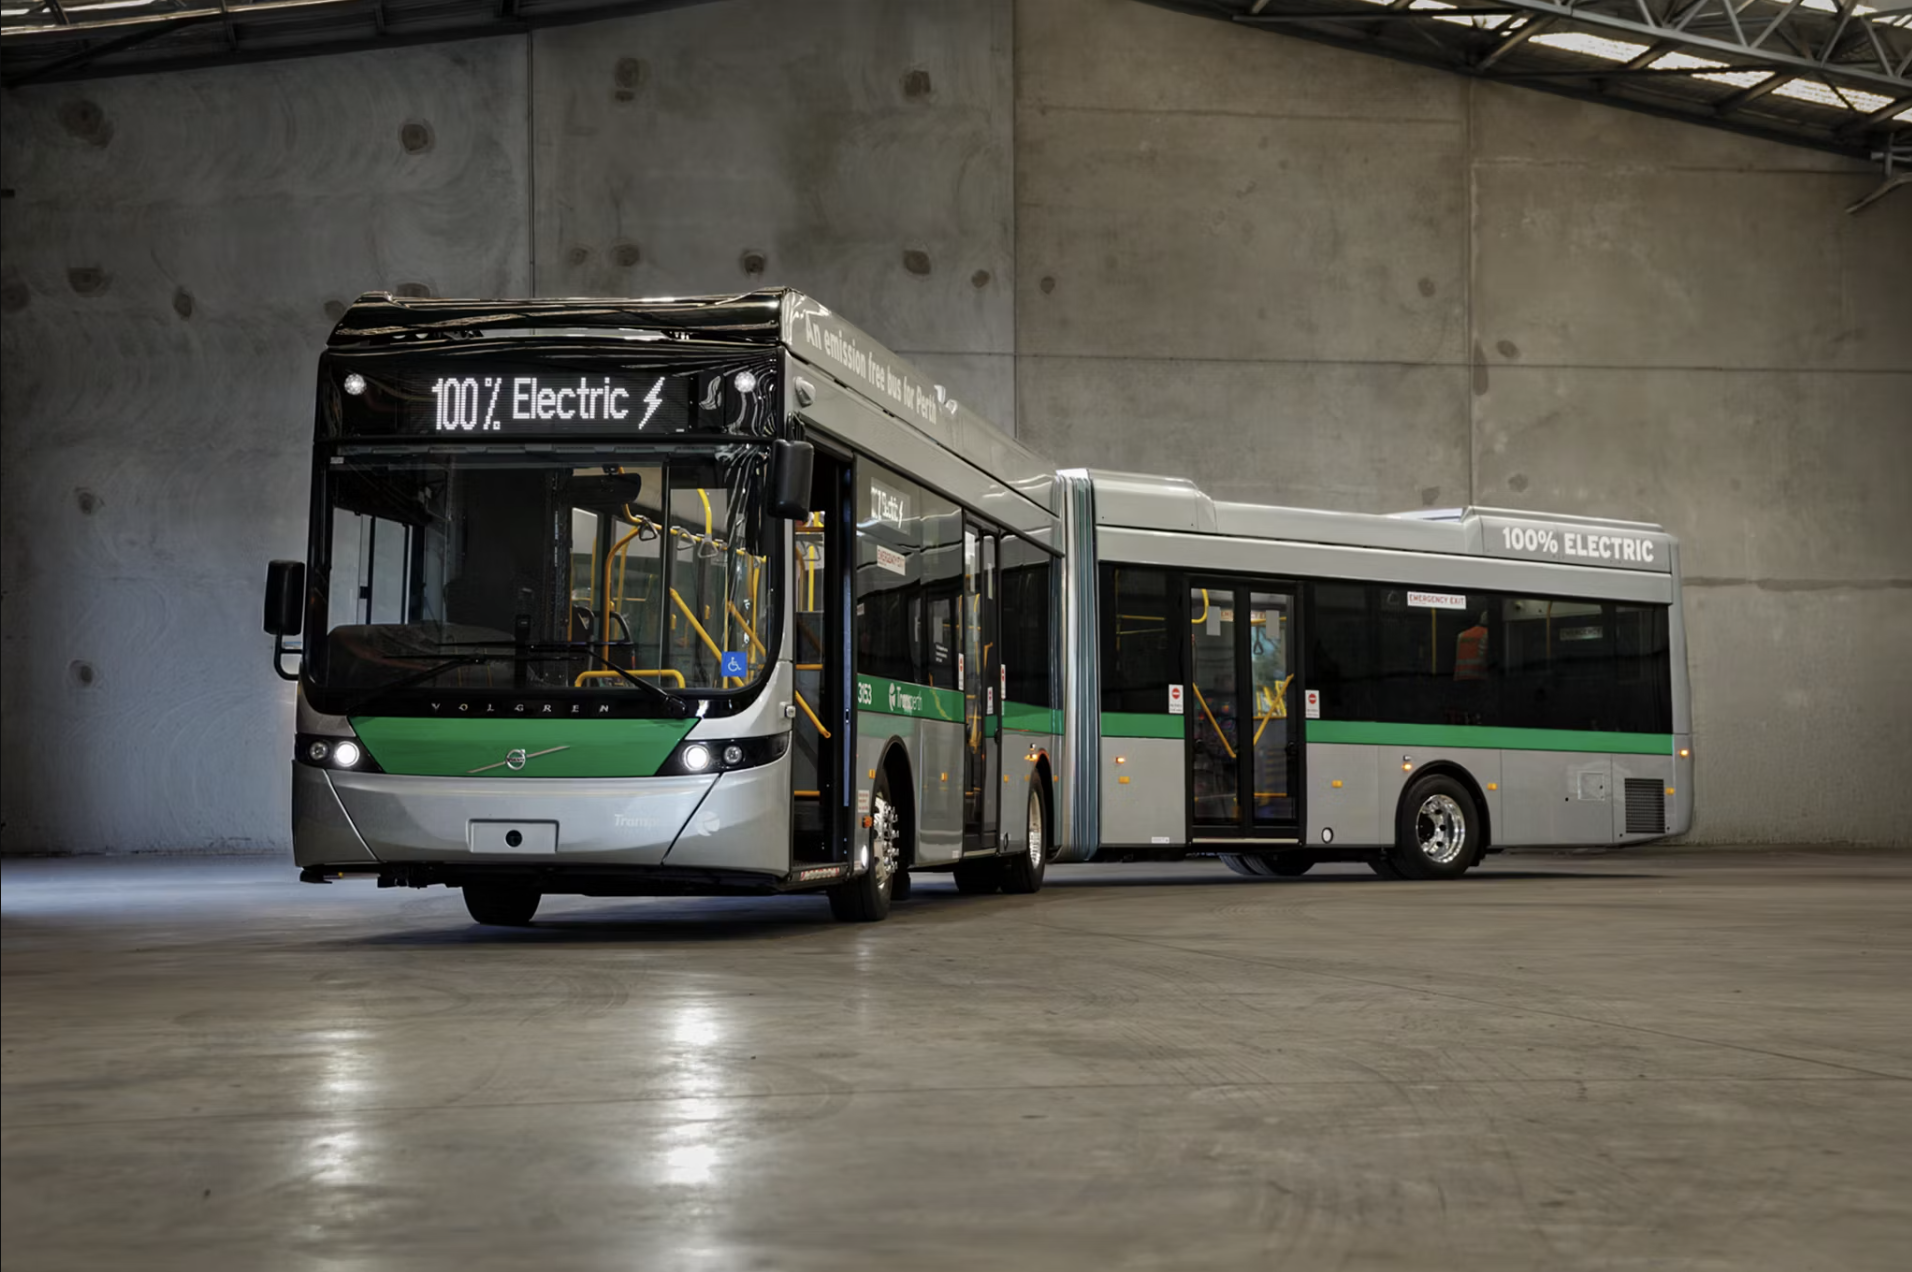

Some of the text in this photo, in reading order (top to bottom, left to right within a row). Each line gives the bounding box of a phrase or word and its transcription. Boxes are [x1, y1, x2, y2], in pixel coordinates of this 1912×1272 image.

[805, 318, 937, 424] An emission free bus for Perth
[431, 377, 630, 430] 100% Electric
[1502, 526, 1654, 563] 100% ELECTRIC
[431, 702, 609, 713] VOLGREN
